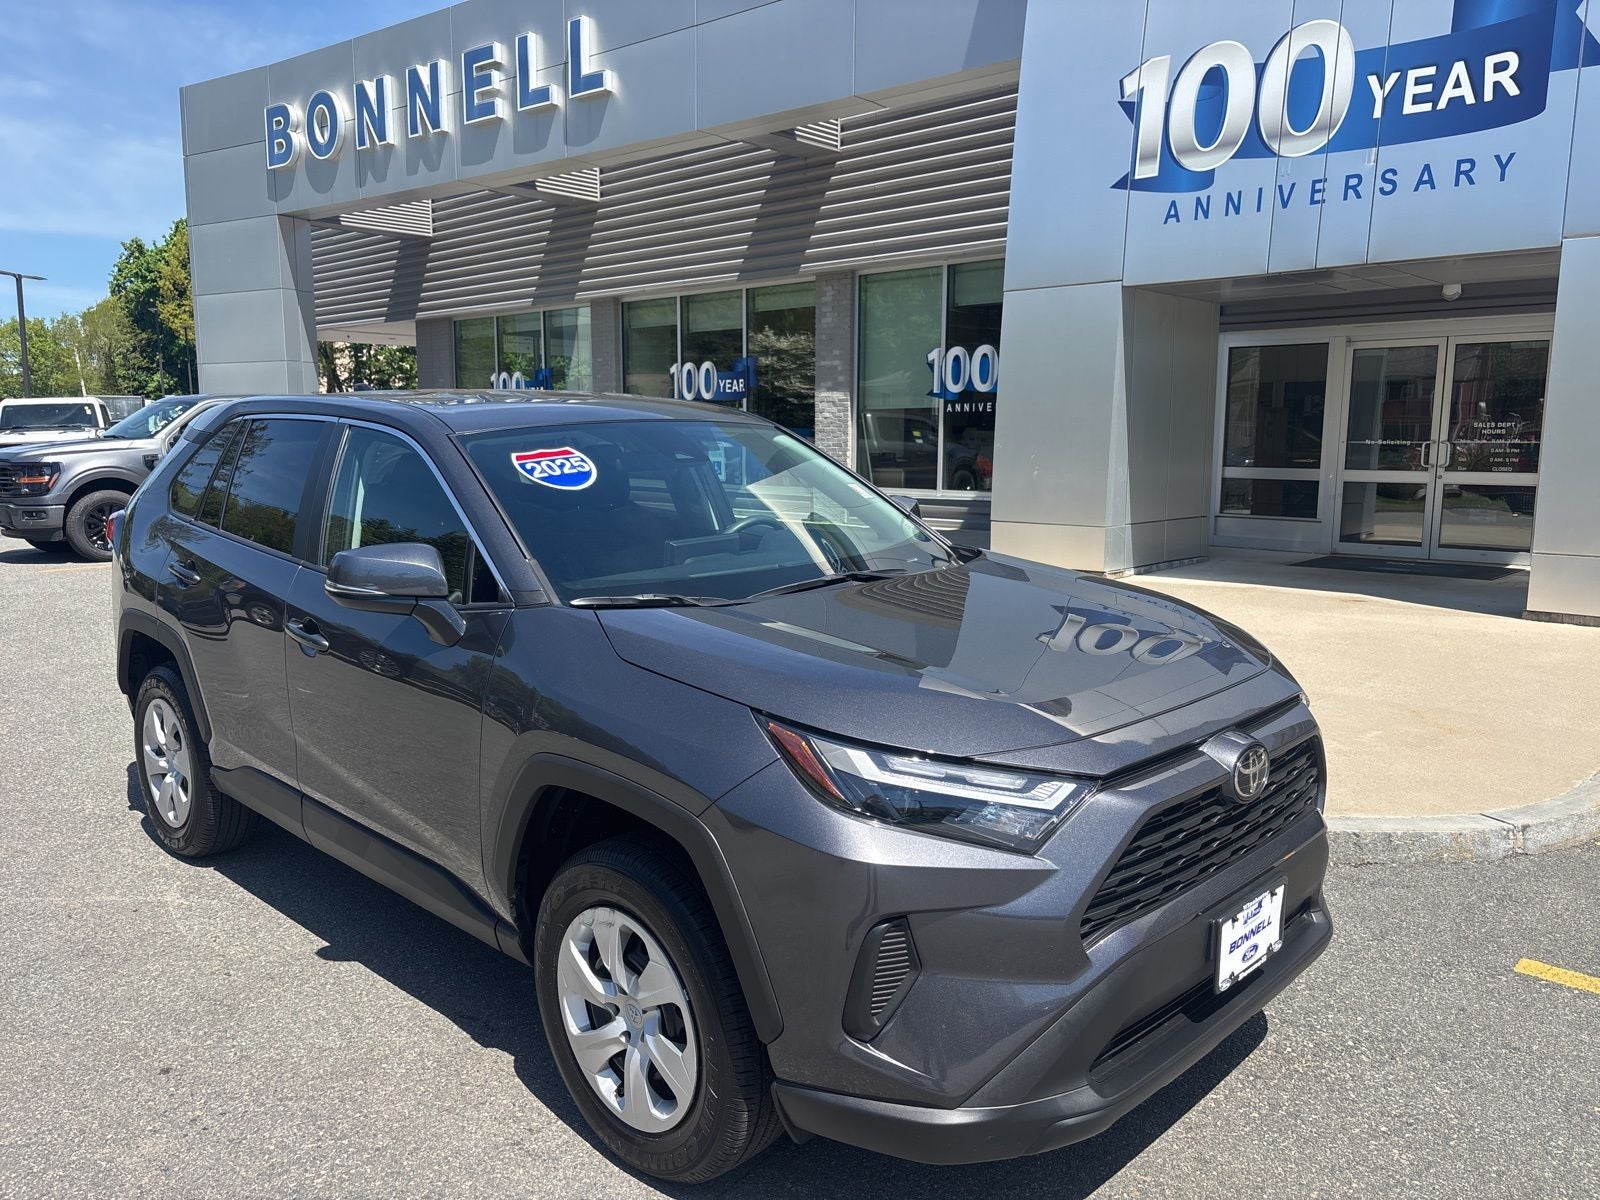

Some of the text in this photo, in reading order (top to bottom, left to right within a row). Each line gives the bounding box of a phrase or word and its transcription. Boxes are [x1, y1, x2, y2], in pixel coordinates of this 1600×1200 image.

[264, 15, 613, 169] BONNELL
[1122, 19, 1522, 180] 100 YEAR
[1163, 152, 1516, 225] ANNIVERSARY
[669, 361, 746, 400] 100 YEAR
[927, 344, 999, 393] 100
[946, 402, 993, 412] ANNIVE
[525, 457, 591, 478] 2025
[1228, 915, 1273, 955] BONNELL
